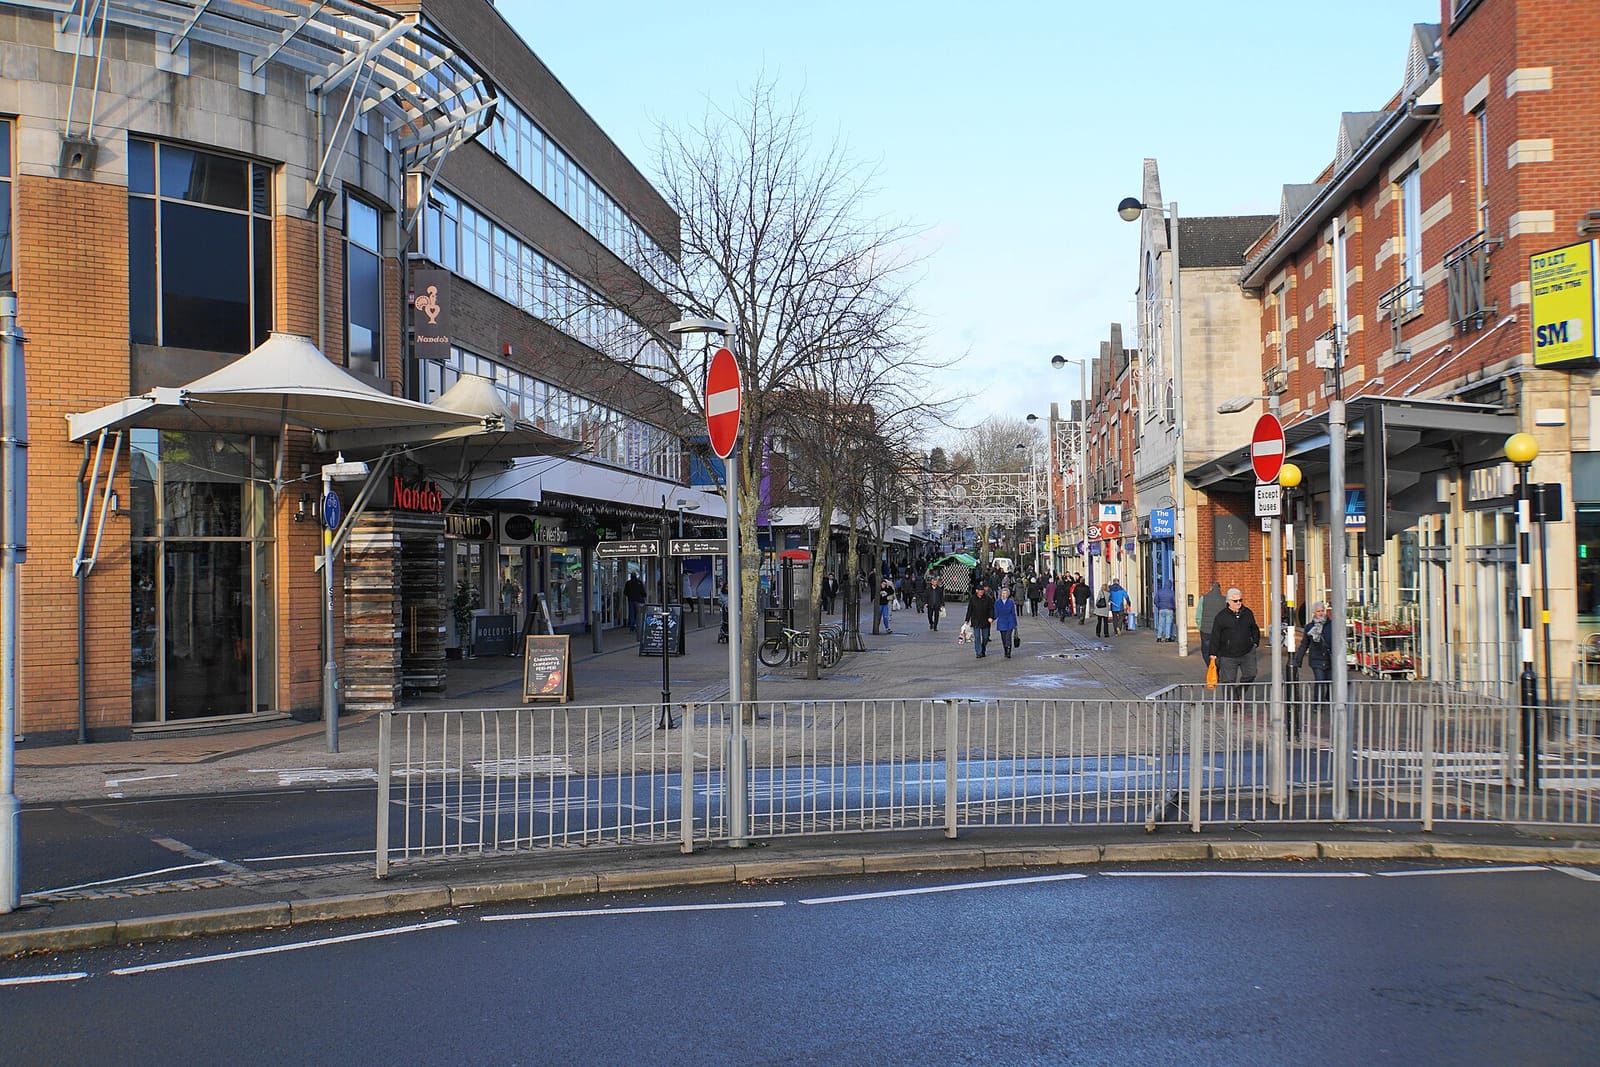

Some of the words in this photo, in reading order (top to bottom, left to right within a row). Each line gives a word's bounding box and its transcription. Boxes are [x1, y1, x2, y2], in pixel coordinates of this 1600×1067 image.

[1534, 258, 1546, 270] TO
[1548, 253, 1566, 266] LET
[416, 335, 449, 343] Nando's
[392, 475, 442, 512] Nando's
[1257, 489, 1279, 500] Except
[1258, 503, 1277, 511] buses
[1156, 518, 1169, 527] Toy
[1345, 515, 1367, 524] ALD
[1153, 526, 1172, 534] Shop
